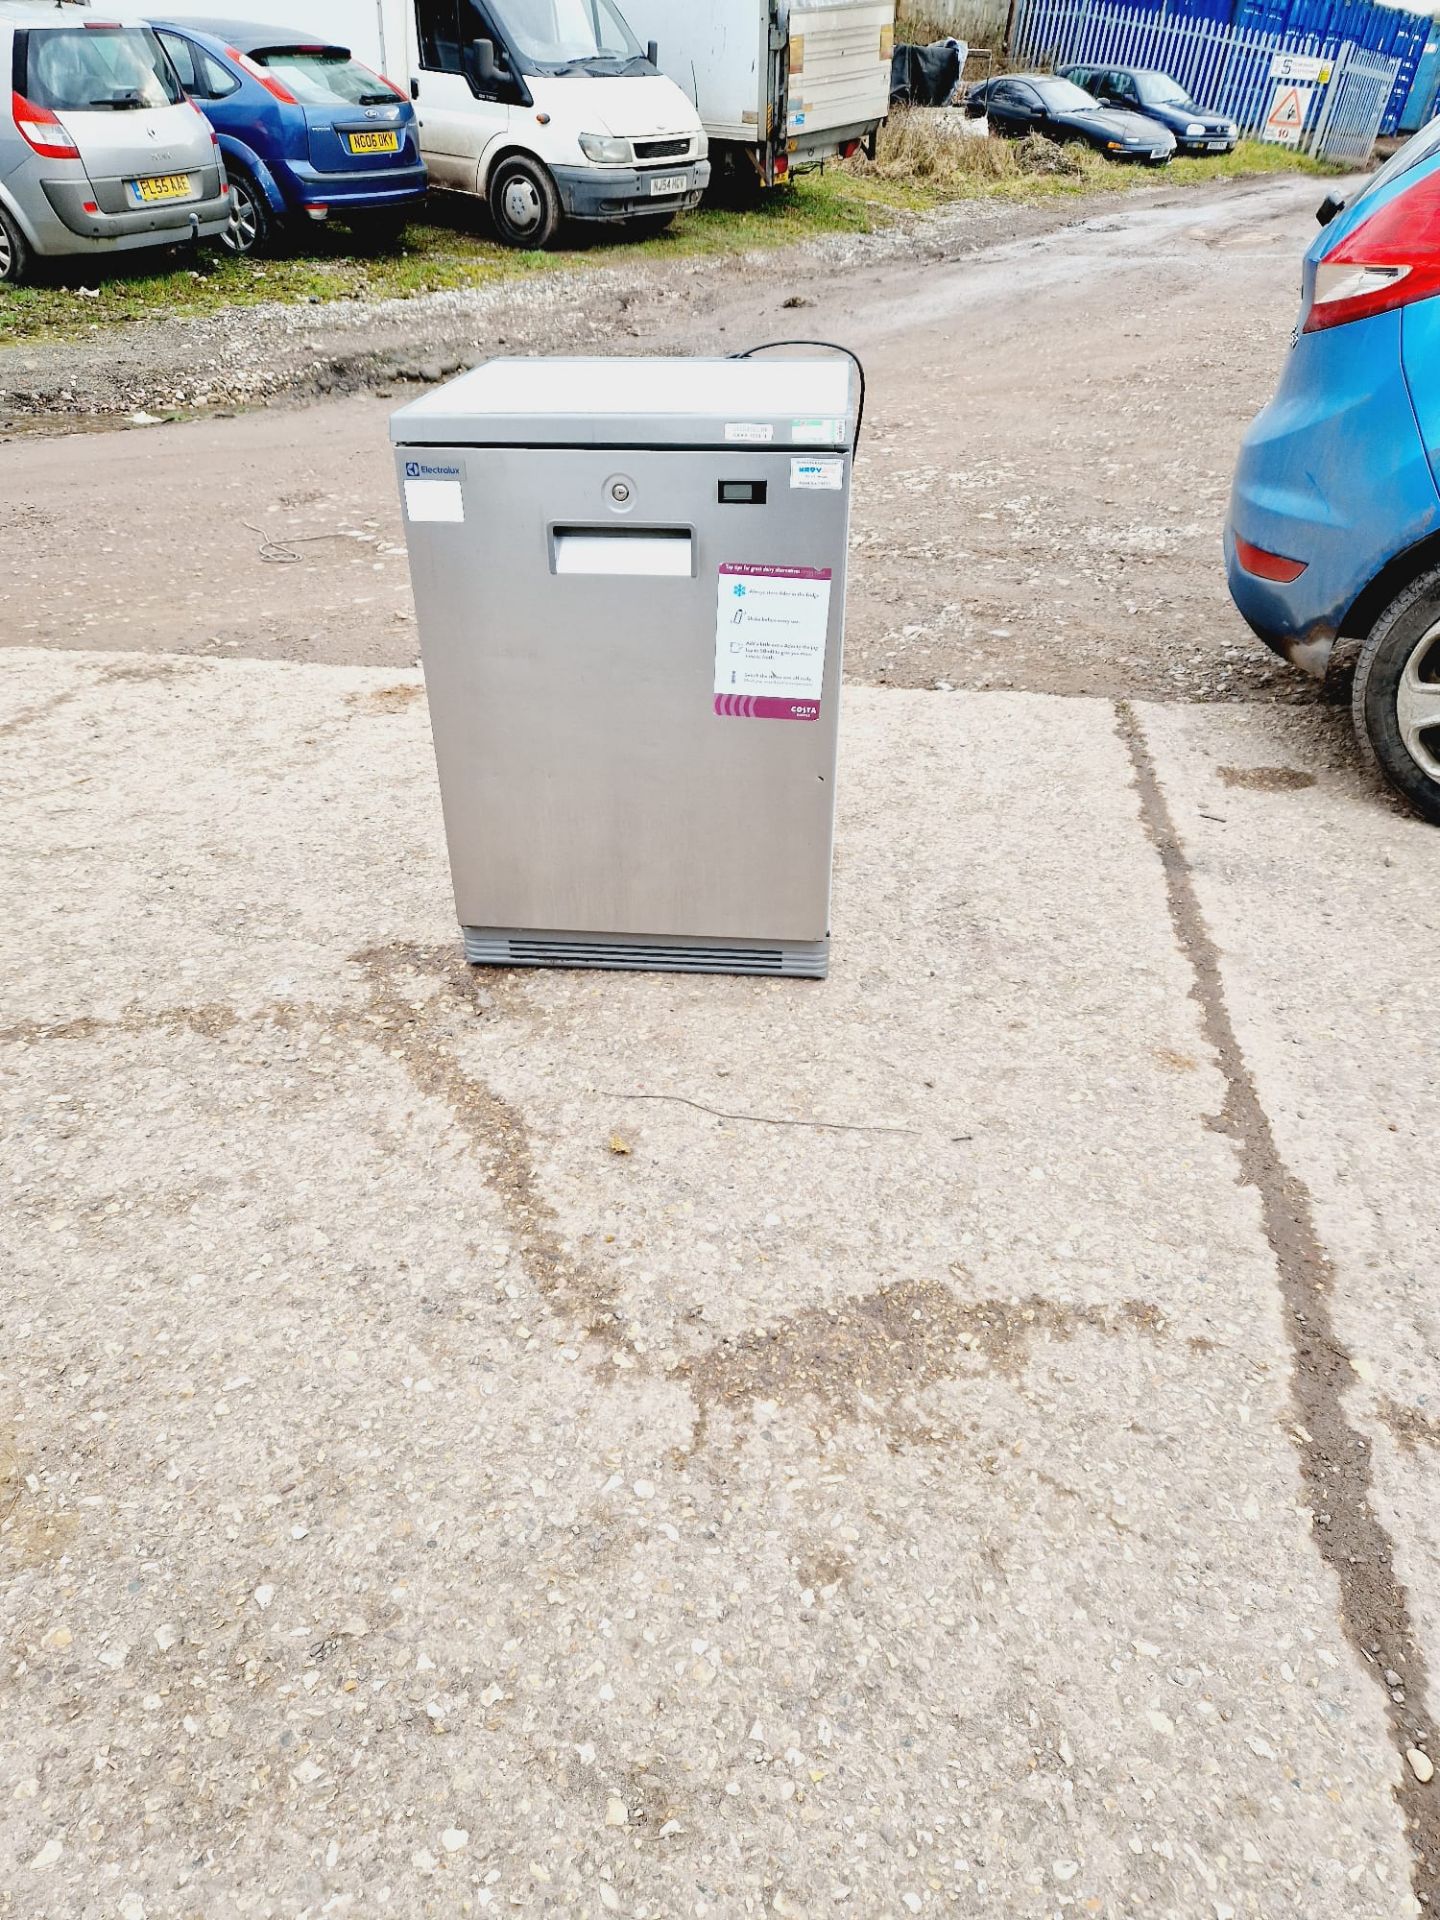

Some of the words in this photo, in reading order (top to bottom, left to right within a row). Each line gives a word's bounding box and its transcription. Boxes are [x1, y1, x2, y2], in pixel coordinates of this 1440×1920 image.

[420, 465, 460, 474] Electrolux
[750, 565, 761, 573] great
[790, 706, 817, 714] COSTA
